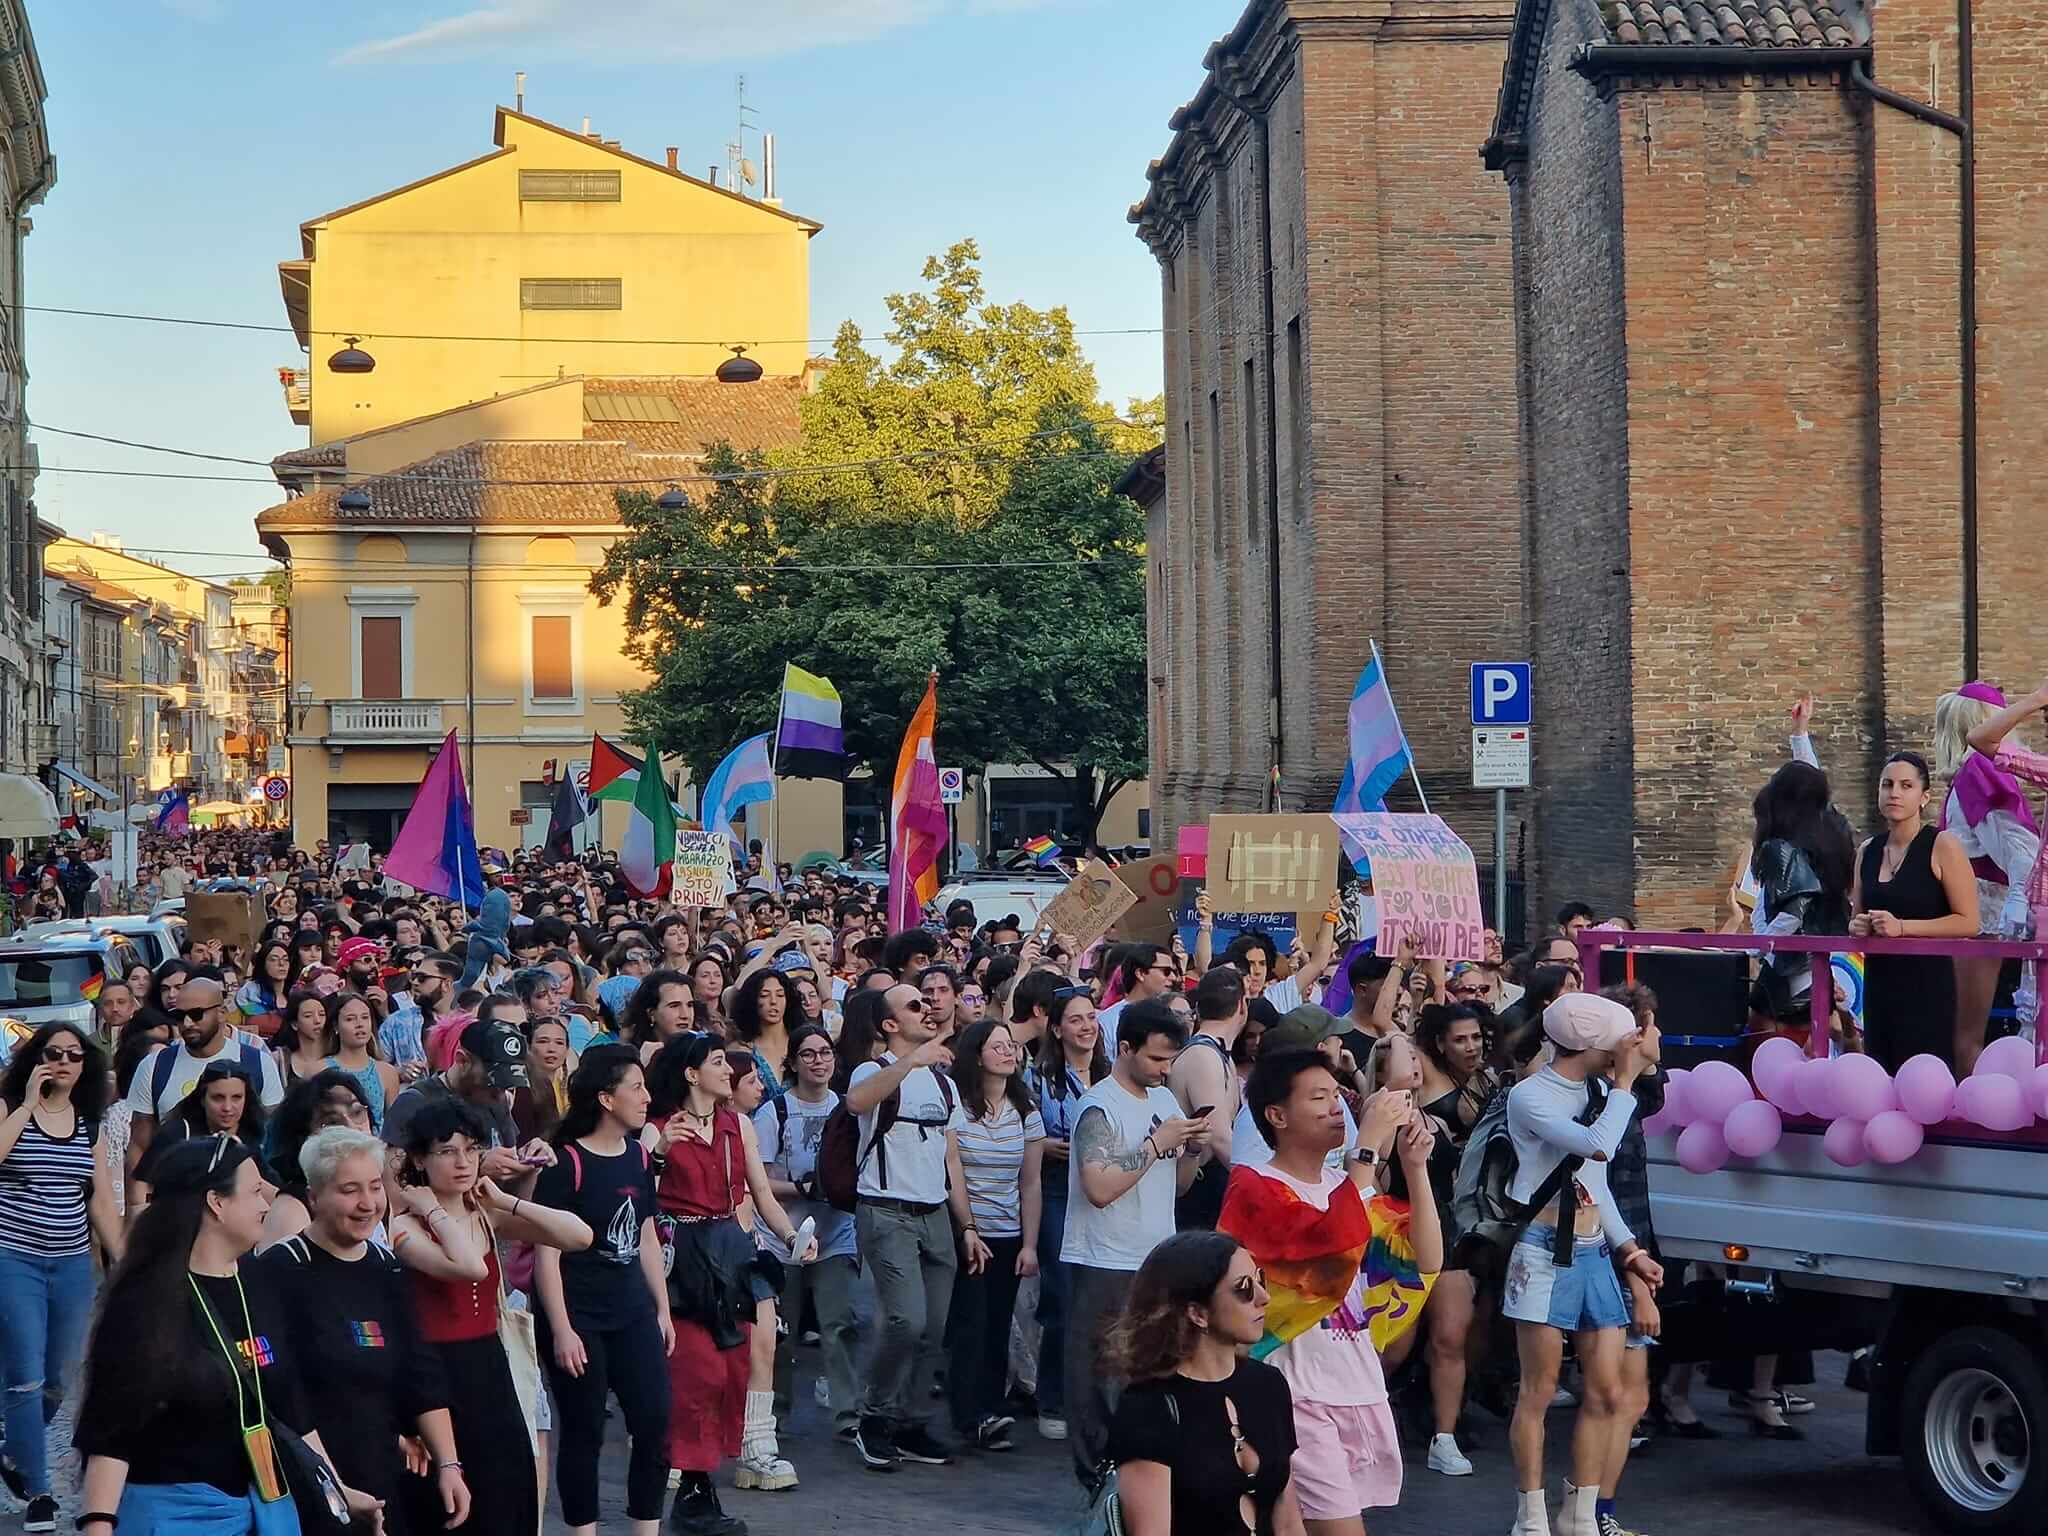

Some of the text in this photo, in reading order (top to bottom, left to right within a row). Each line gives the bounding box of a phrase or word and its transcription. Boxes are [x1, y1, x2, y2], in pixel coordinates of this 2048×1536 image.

[1484, 669, 1518, 718] P
[680, 842, 716, 853] SENZA
[686, 878, 712, 890] STO
[1380, 889, 1470, 921] FOR YOU
[1241, 911, 1289, 927] gender
